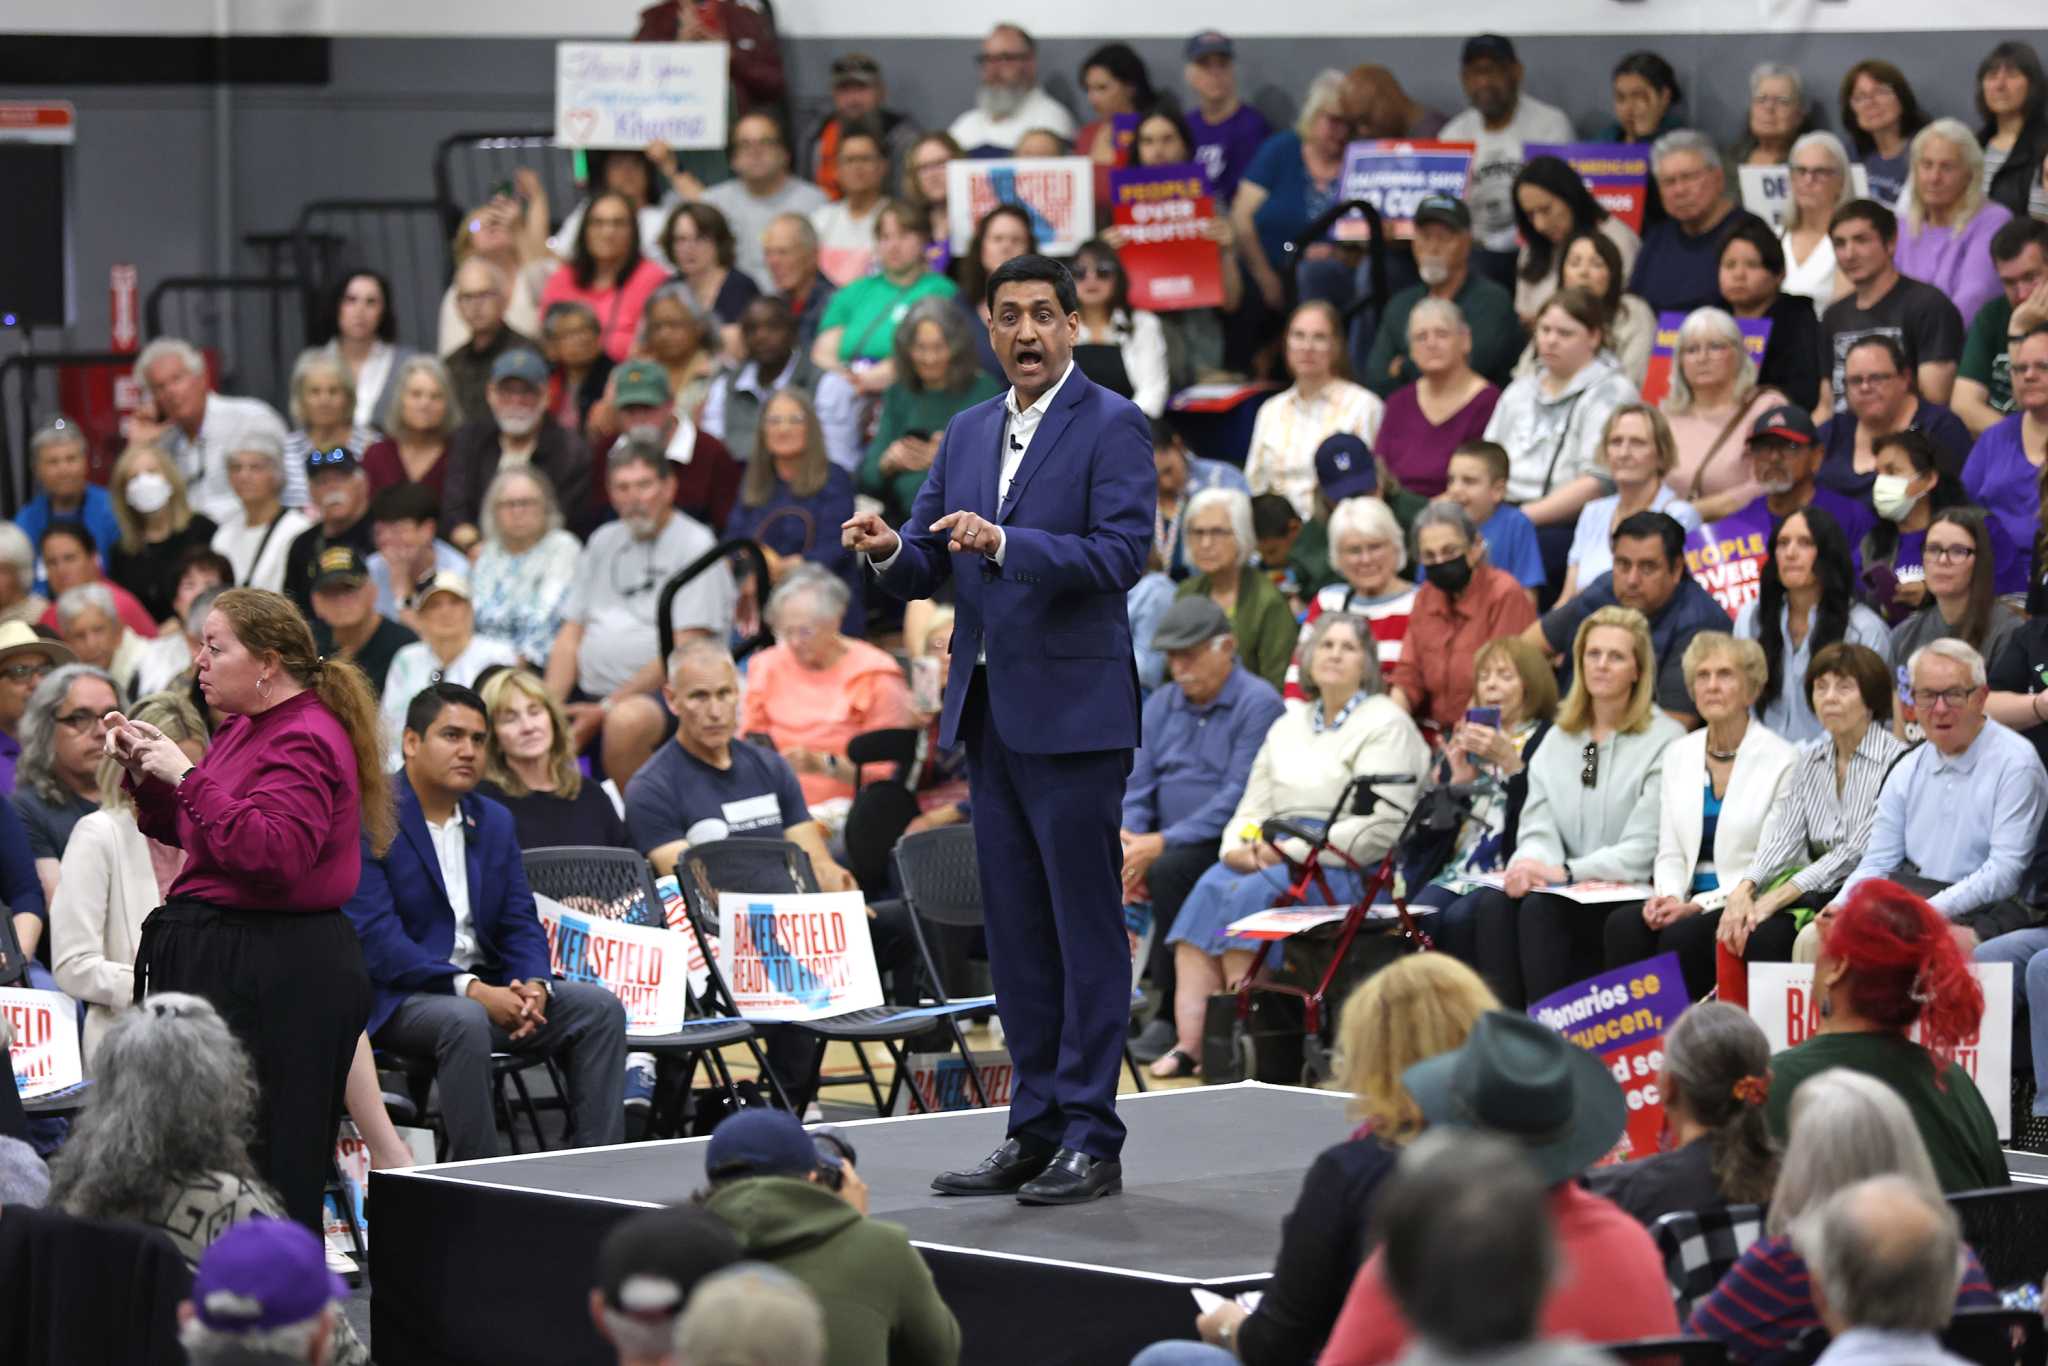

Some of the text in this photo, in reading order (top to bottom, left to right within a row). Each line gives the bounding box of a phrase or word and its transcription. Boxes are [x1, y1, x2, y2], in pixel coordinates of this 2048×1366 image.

[1686, 533, 1763, 572] EOPLE
[733, 911, 847, 957] BAKERSFIELD
[733, 958, 769, 993] READY
[774, 958, 794, 993] TO
[1629, 974, 1660, 999] se
[1562, 1008, 1662, 1050] quecen,
